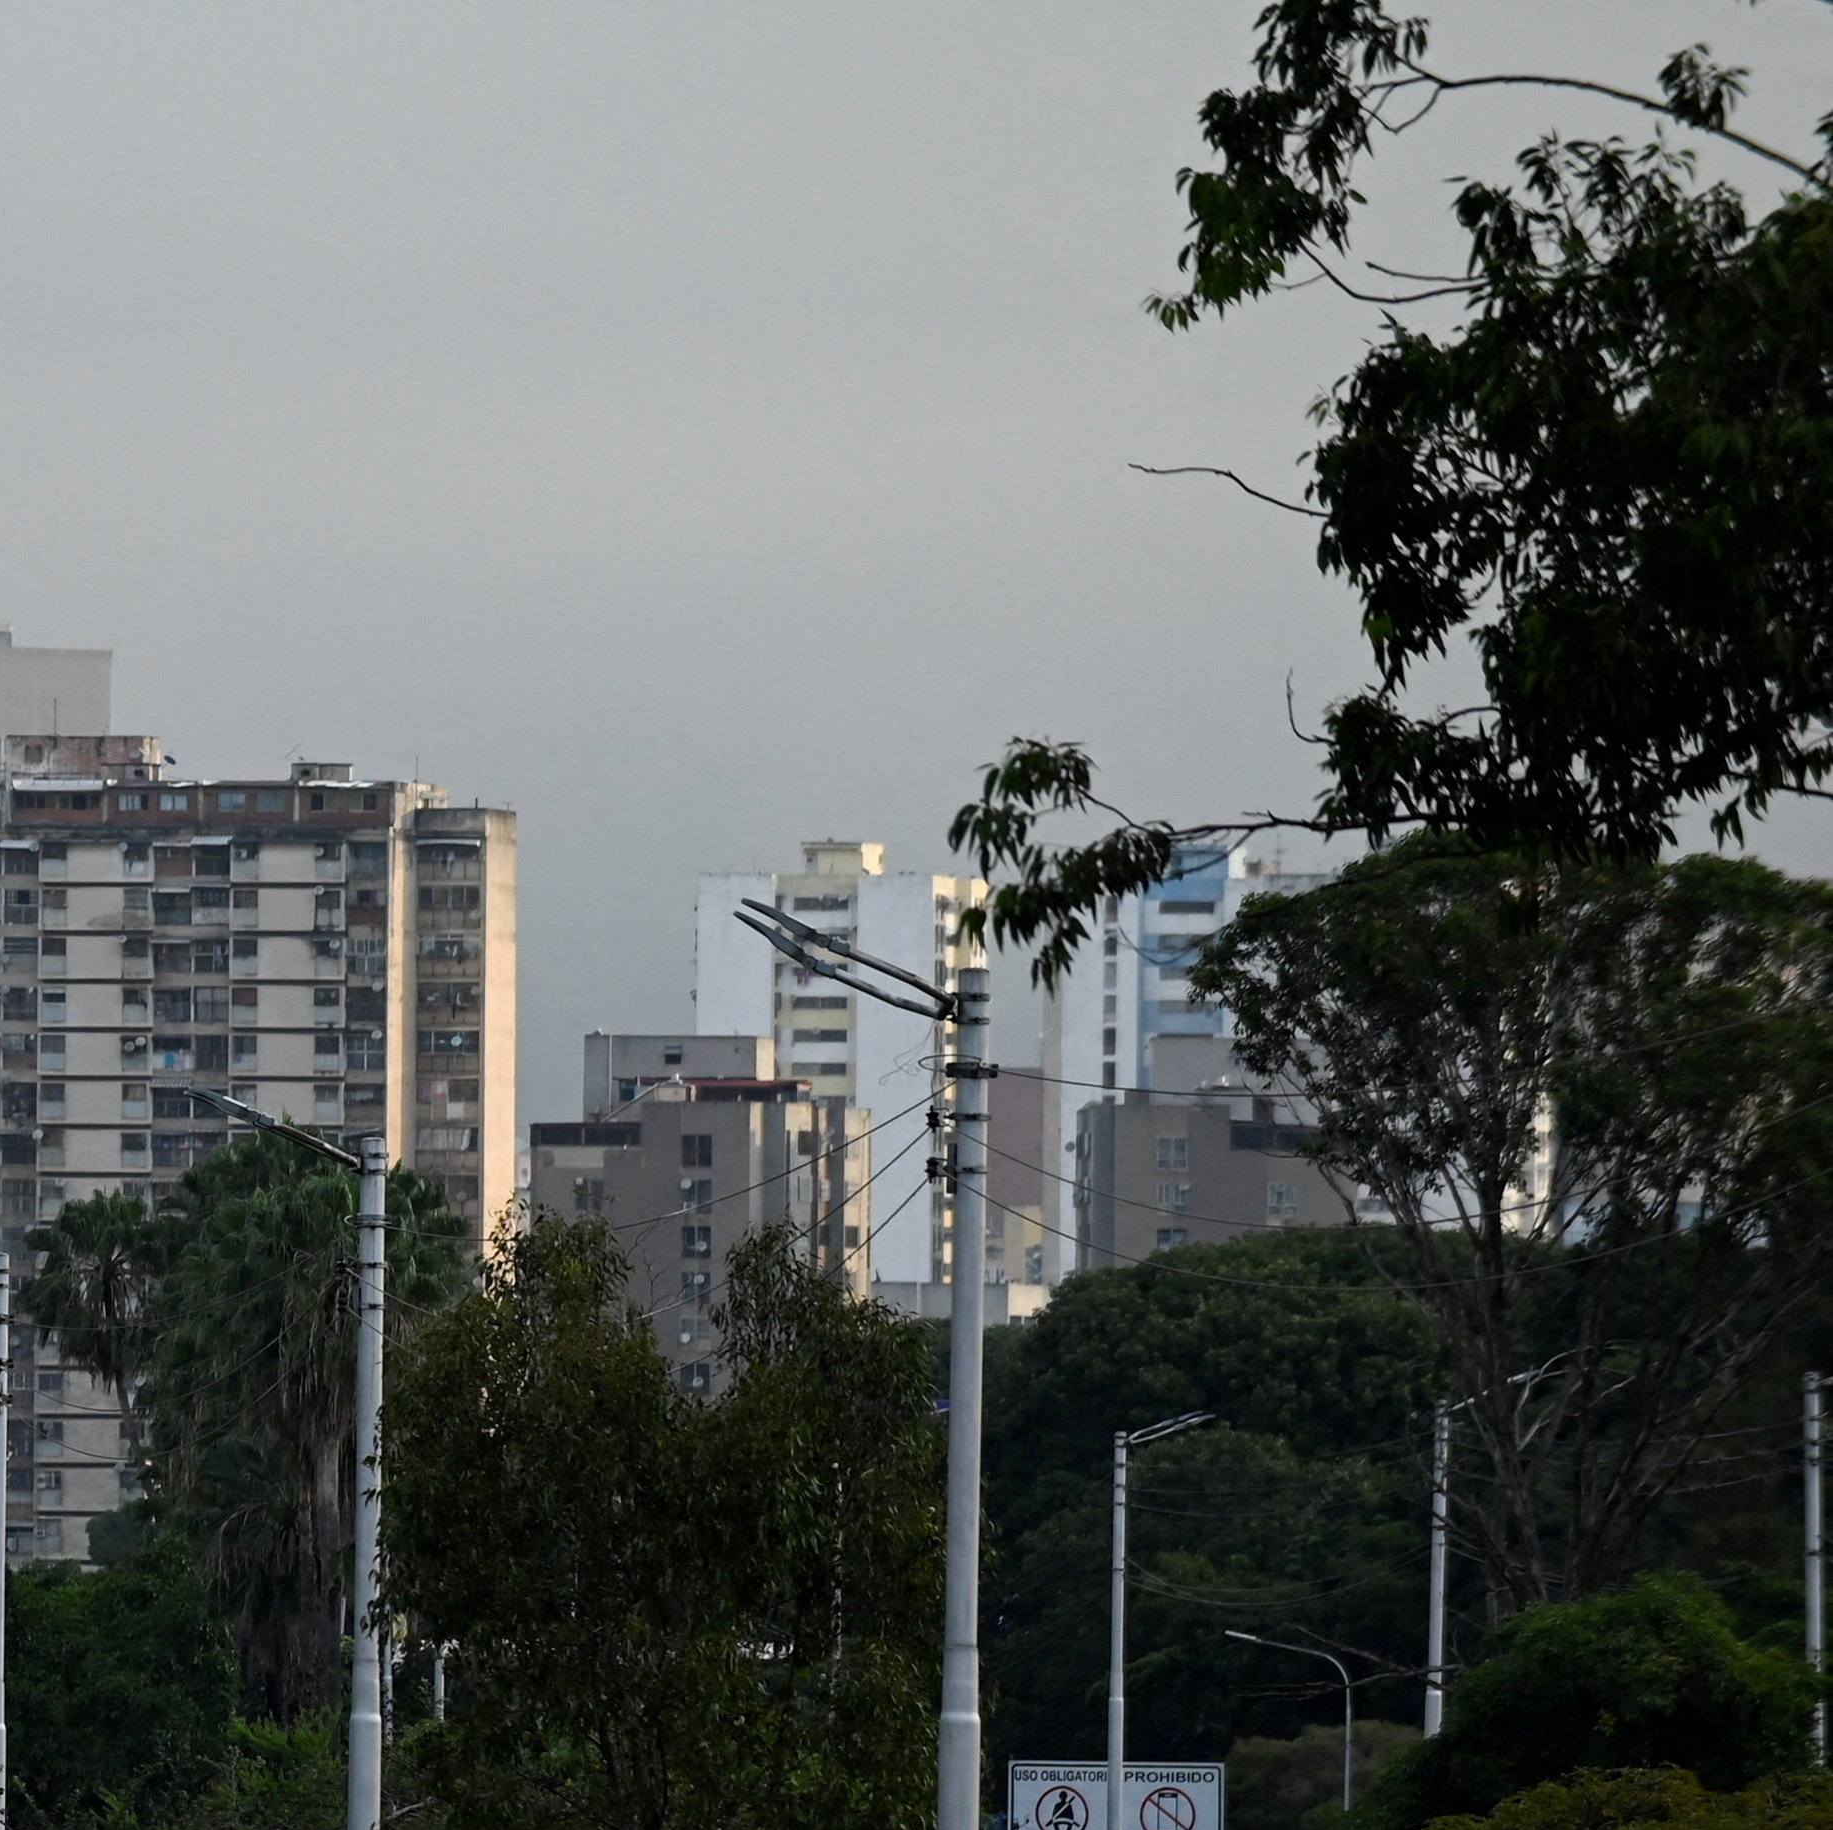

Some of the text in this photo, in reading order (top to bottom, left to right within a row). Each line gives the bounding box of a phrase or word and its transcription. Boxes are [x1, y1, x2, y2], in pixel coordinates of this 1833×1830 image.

[1015, 1770, 1107, 1782] USO OBLIGATORI
[1124, 1771, 1215, 1783] PROHIBIDO
